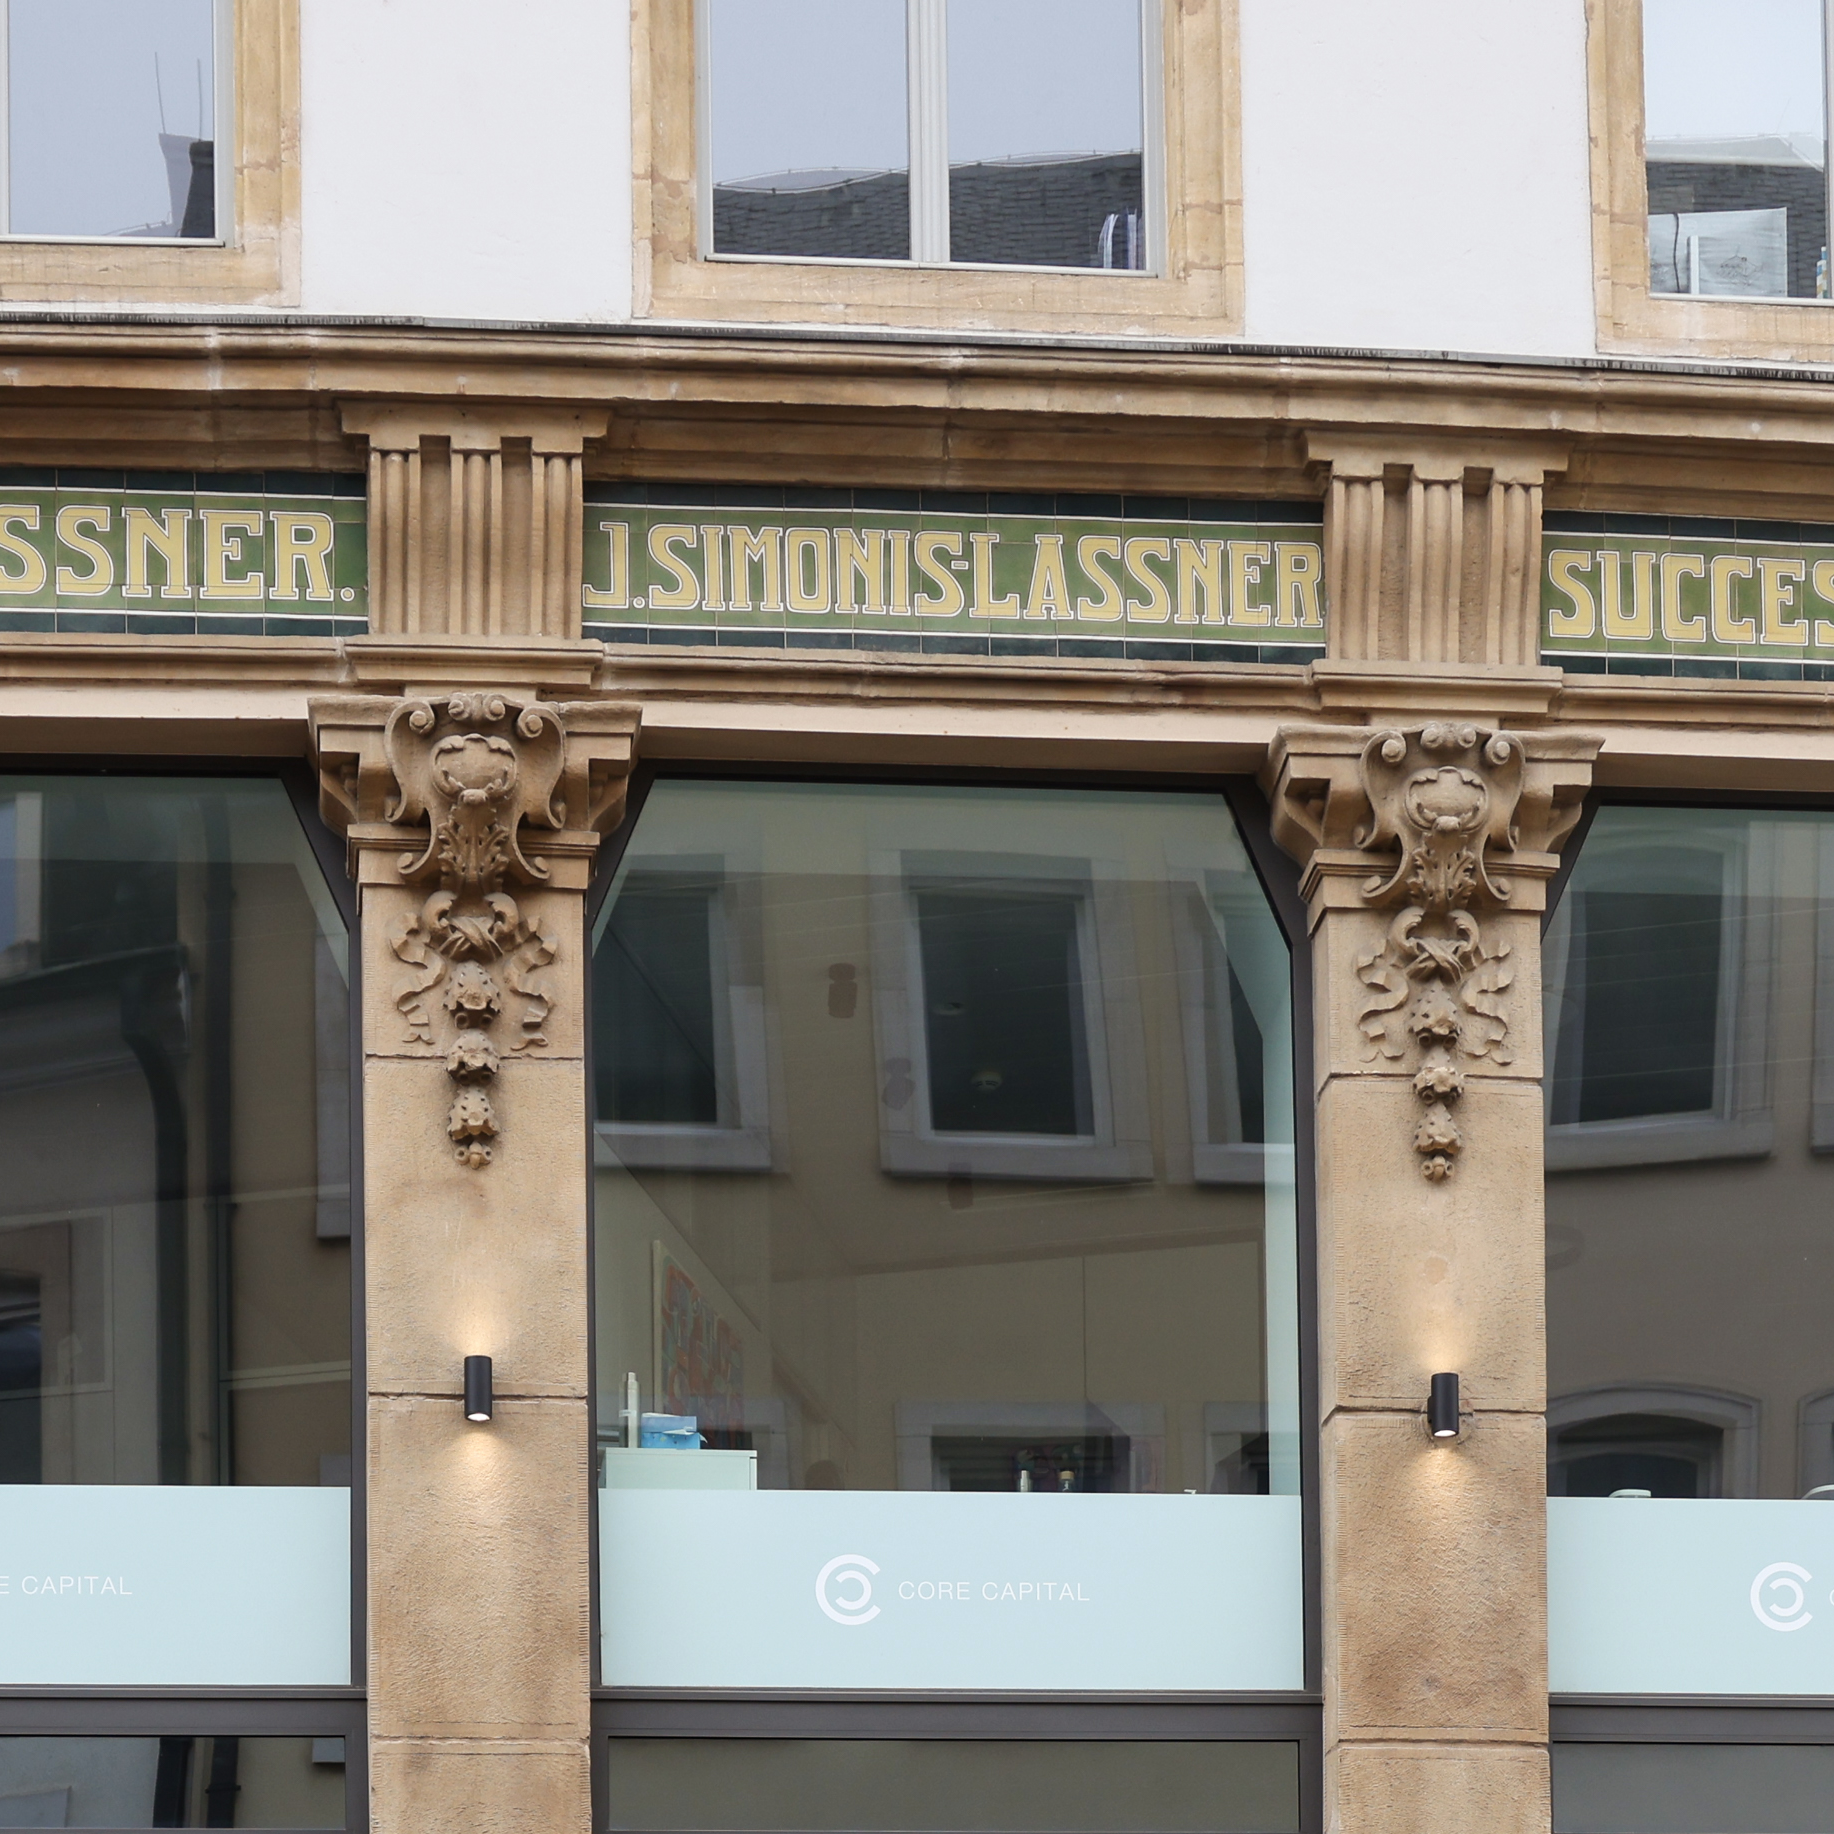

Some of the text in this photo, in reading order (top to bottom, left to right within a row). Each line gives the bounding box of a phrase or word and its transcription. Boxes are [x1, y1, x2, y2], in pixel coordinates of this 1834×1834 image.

[21, 1574, 134, 1597] CAPITAL
[897, 1580, 1092, 1602] CORE CAPITAL
